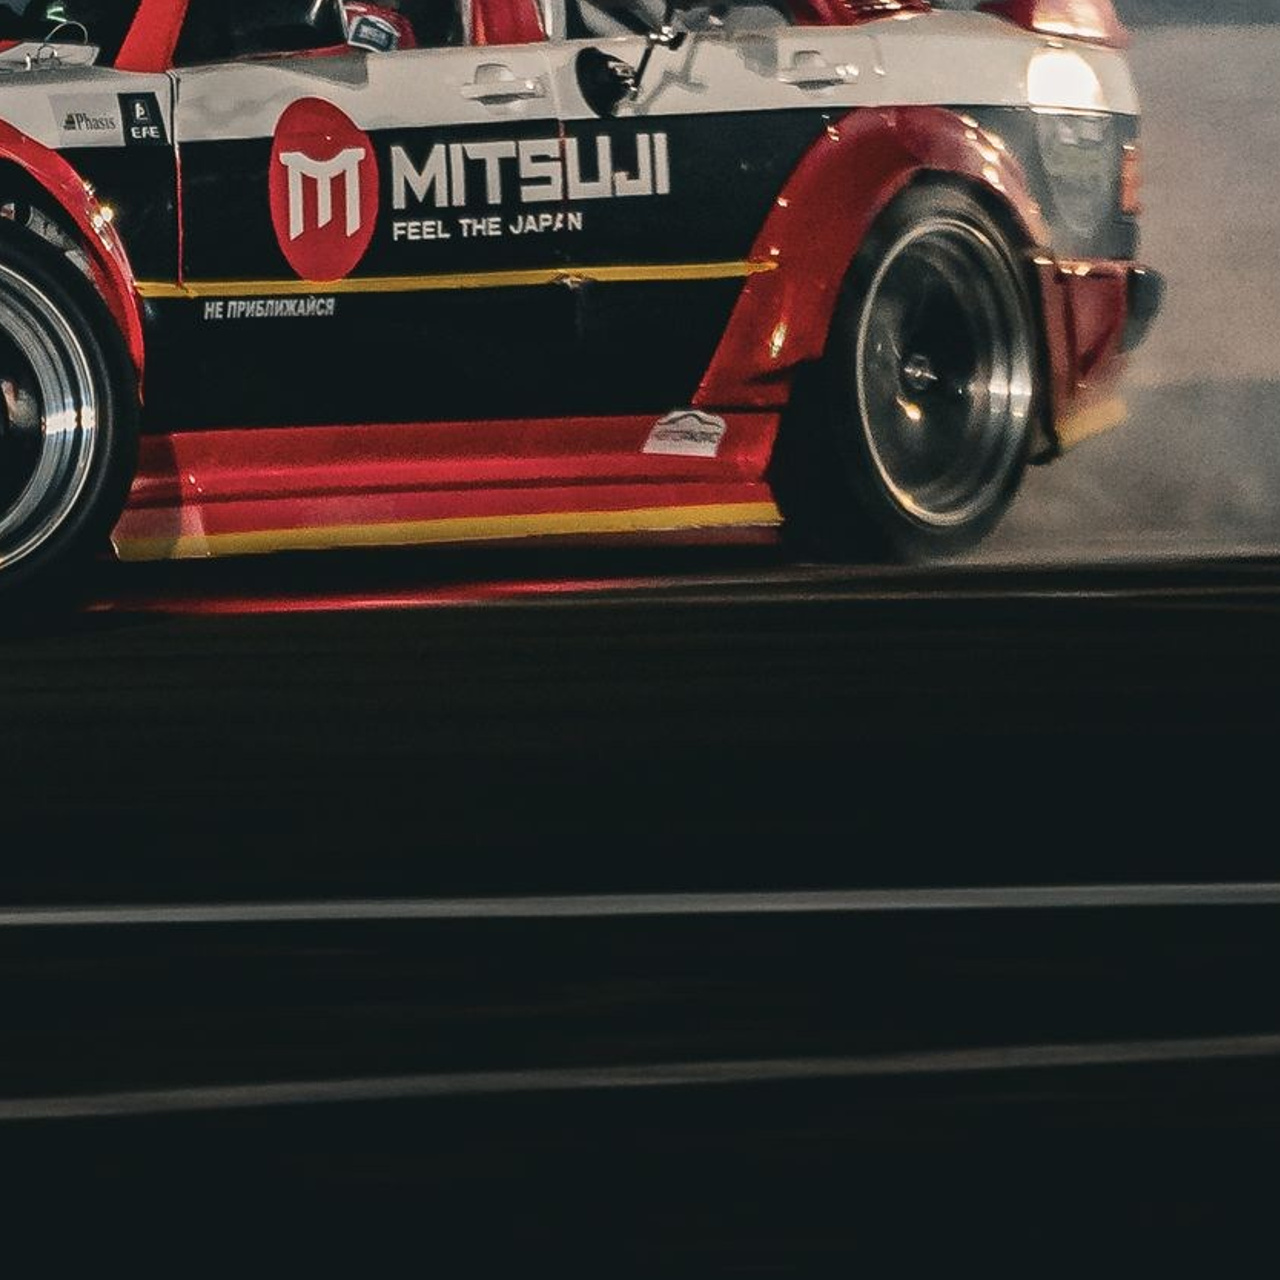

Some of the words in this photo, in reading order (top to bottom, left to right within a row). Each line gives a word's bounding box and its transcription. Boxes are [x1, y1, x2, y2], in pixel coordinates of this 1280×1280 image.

[75, 112, 117, 131] Phasis
[390, 133, 669, 210] MITSUJI
[393, 221, 451, 241] FEEL
[459, 217, 502, 238] THE
[204, 301, 224, 320] НЕ
[226, 295, 336, 318] ПРИБЛИЖАЙСЯ
